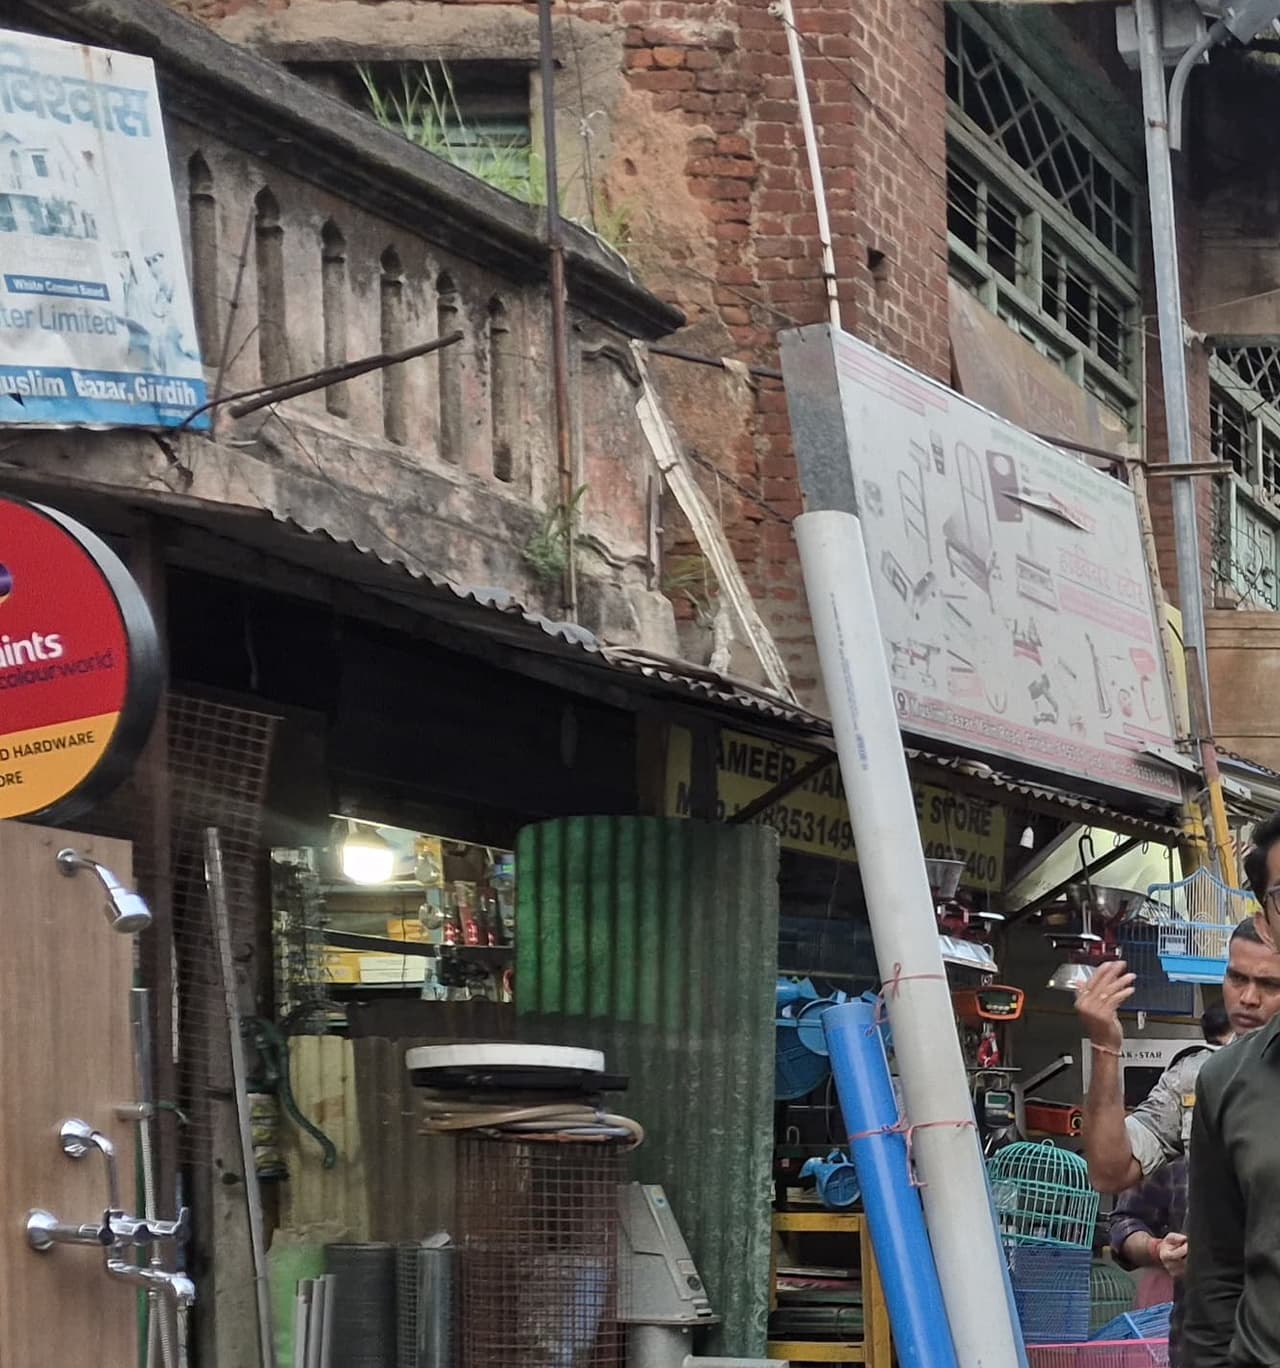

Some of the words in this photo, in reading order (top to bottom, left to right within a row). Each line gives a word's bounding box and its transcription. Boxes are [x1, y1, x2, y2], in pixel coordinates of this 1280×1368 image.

[39, 303, 117, 336] Limited
[0, 369, 68, 397] uslim
[13, 730, 95, 759] HARDWARE
[930, 796, 992, 837] STORE
